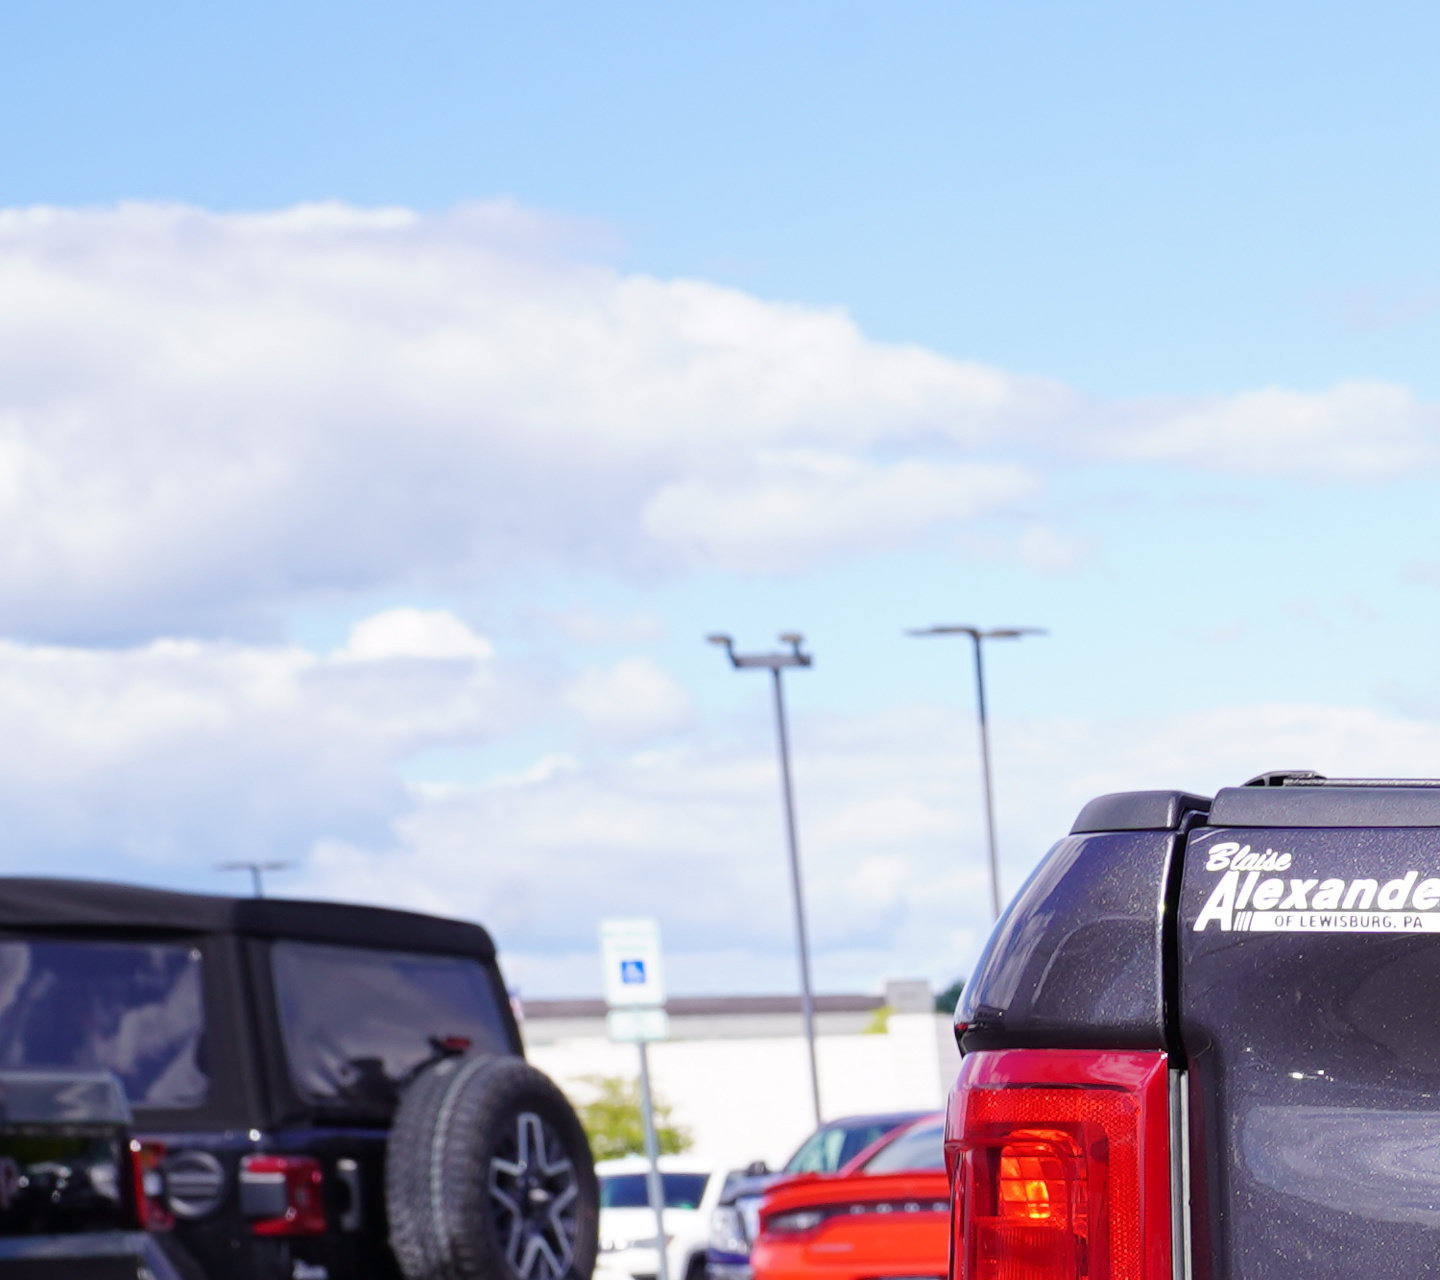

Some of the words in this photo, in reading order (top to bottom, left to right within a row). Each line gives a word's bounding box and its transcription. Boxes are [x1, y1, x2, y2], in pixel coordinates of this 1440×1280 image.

[1206, 842, 1292, 871] Blaise
[1275, 915, 1294, 927] OF
[1404, 916, 1423, 928] PA
